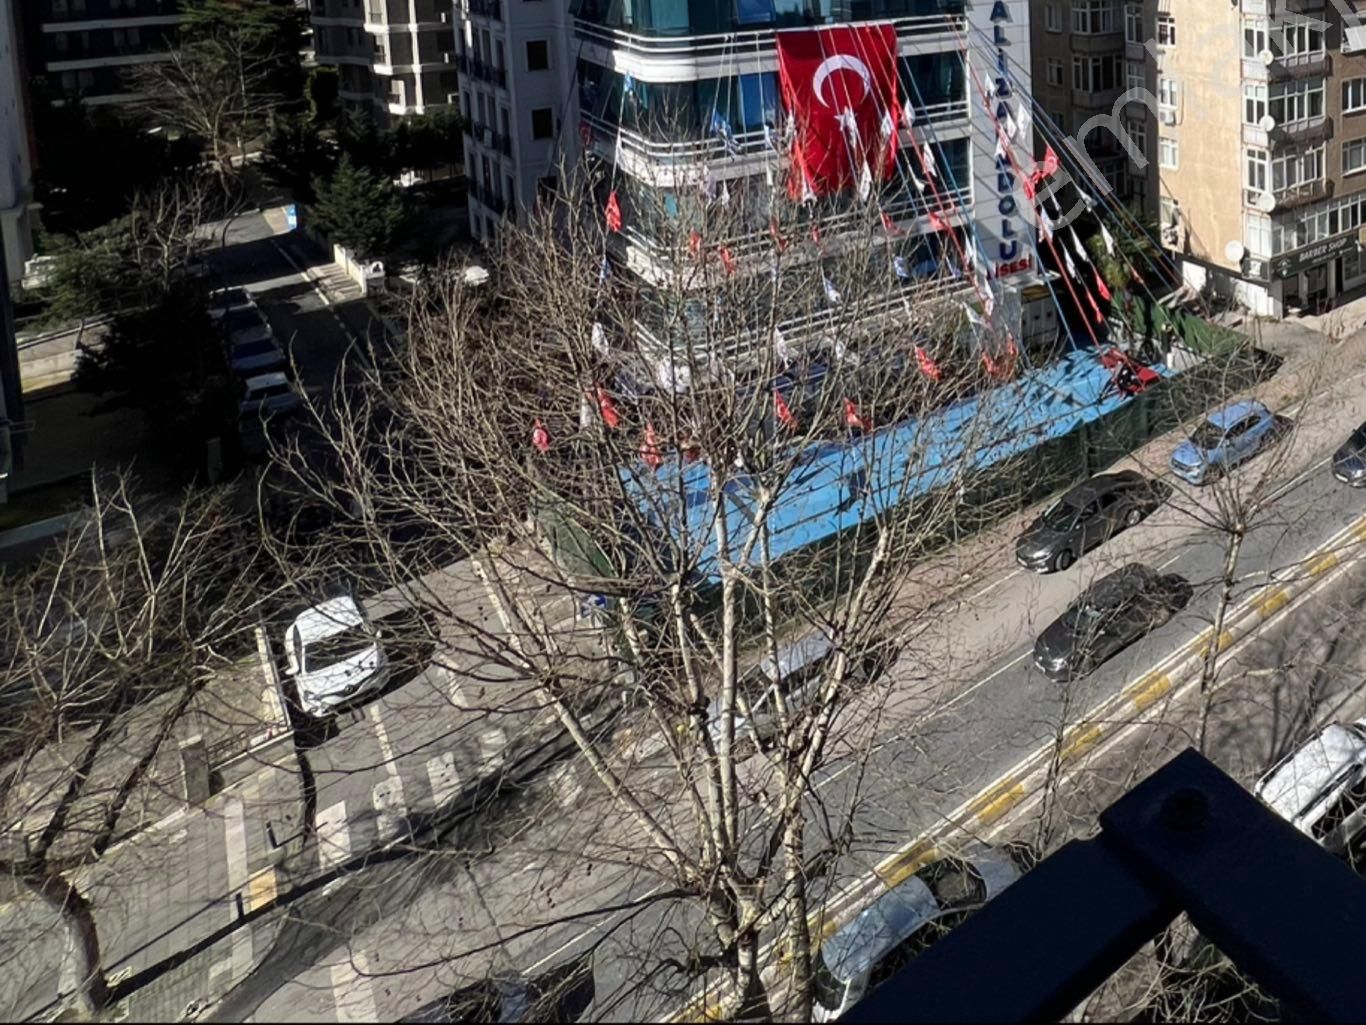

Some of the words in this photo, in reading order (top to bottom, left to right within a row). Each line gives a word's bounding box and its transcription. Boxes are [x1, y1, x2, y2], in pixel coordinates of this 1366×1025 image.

[994, 100, 1018, 261] AADOLU
[1299, 245, 1328, 263] BARBER
[1328, 237, 1348, 253] SHOP
